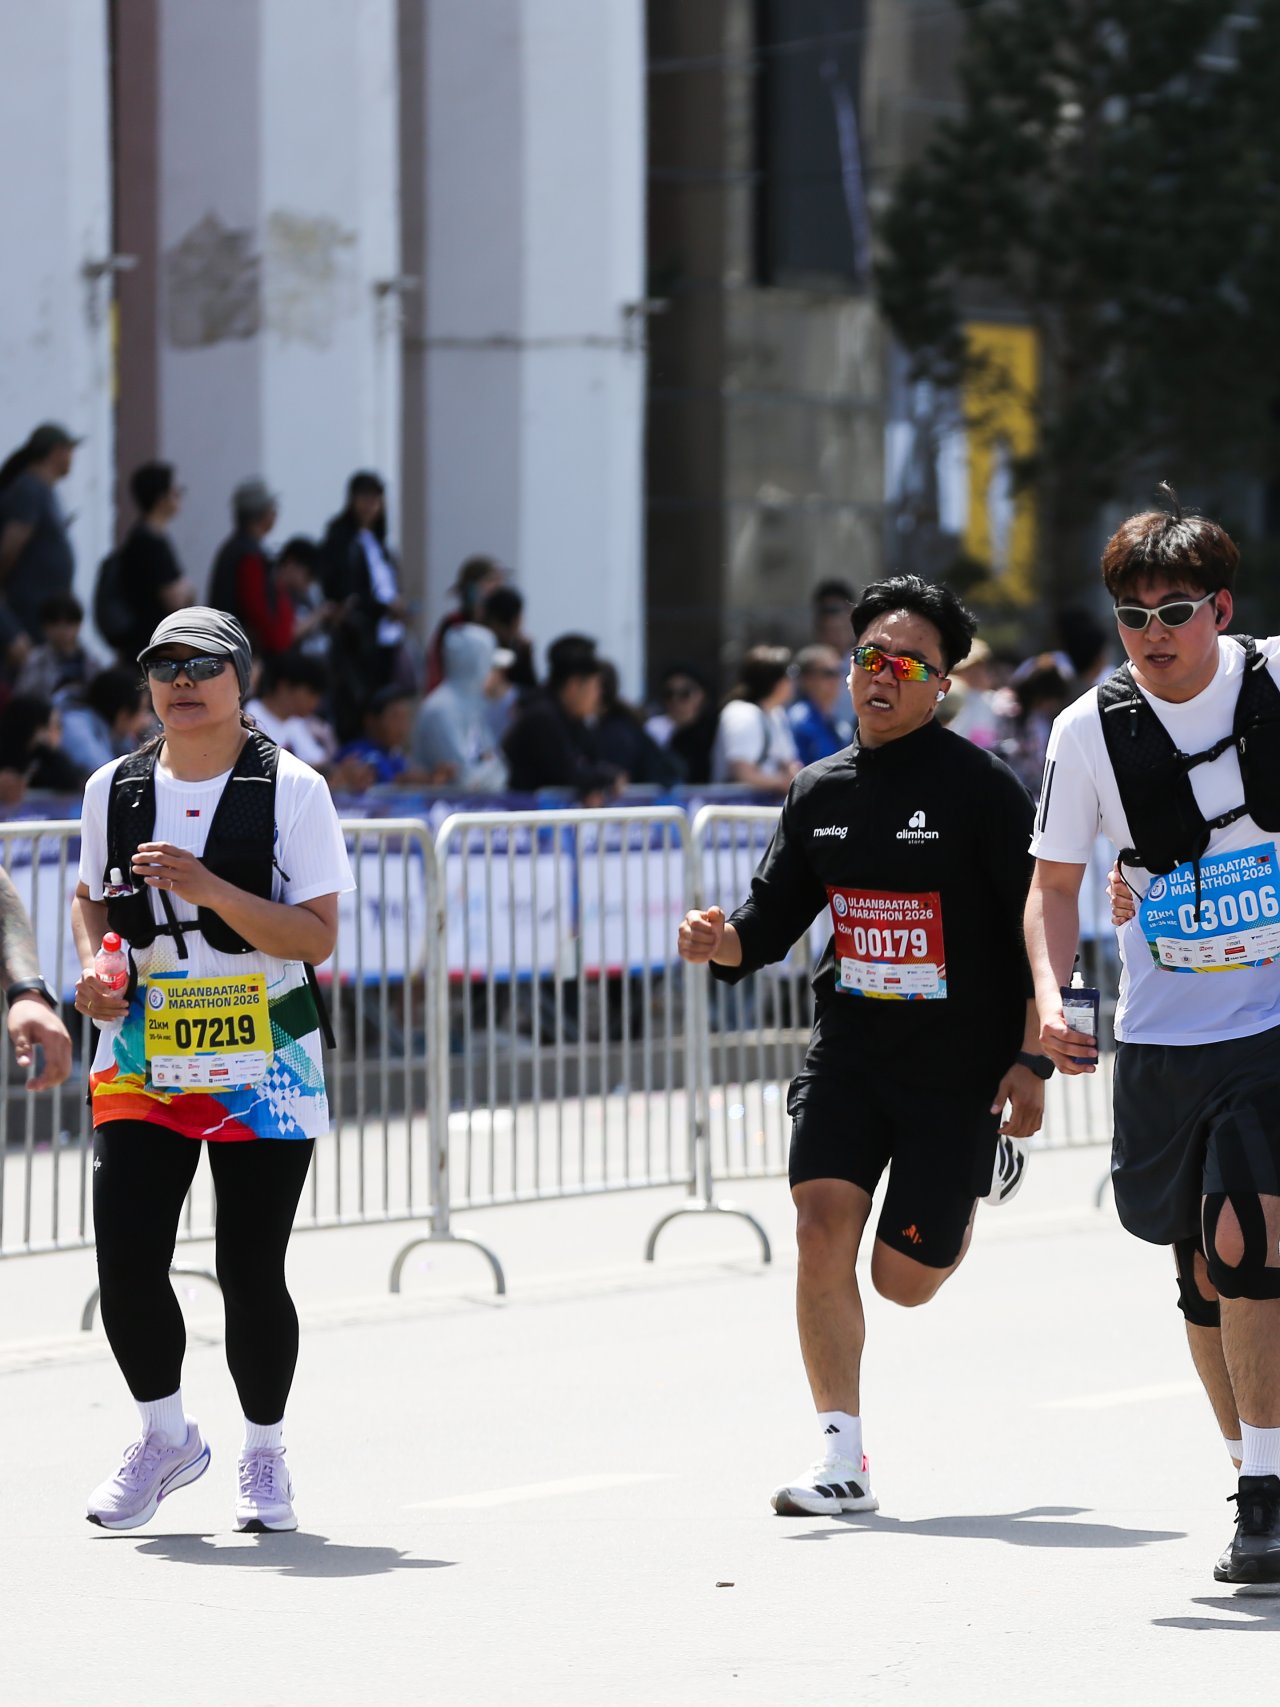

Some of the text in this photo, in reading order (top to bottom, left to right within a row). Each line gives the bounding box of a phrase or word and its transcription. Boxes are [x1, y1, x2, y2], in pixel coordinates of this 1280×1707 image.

[813, 825, 848, 839] muxlog
[896, 829, 939, 839] alimhan
[1243, 864, 1272, 881] 2026
[848, 897, 919, 909] ULAANBAATAR
[1178, 885, 1279, 934] 03006
[849, 908, 933, 920] MARATHON 2026
[853, 926, 928, 958] 00179
[168, 984, 246, 998] ULAANBAATAR
[168, 994, 260, 1009] MARATHON 2026
[175, 1014, 256, 1049] 07219
